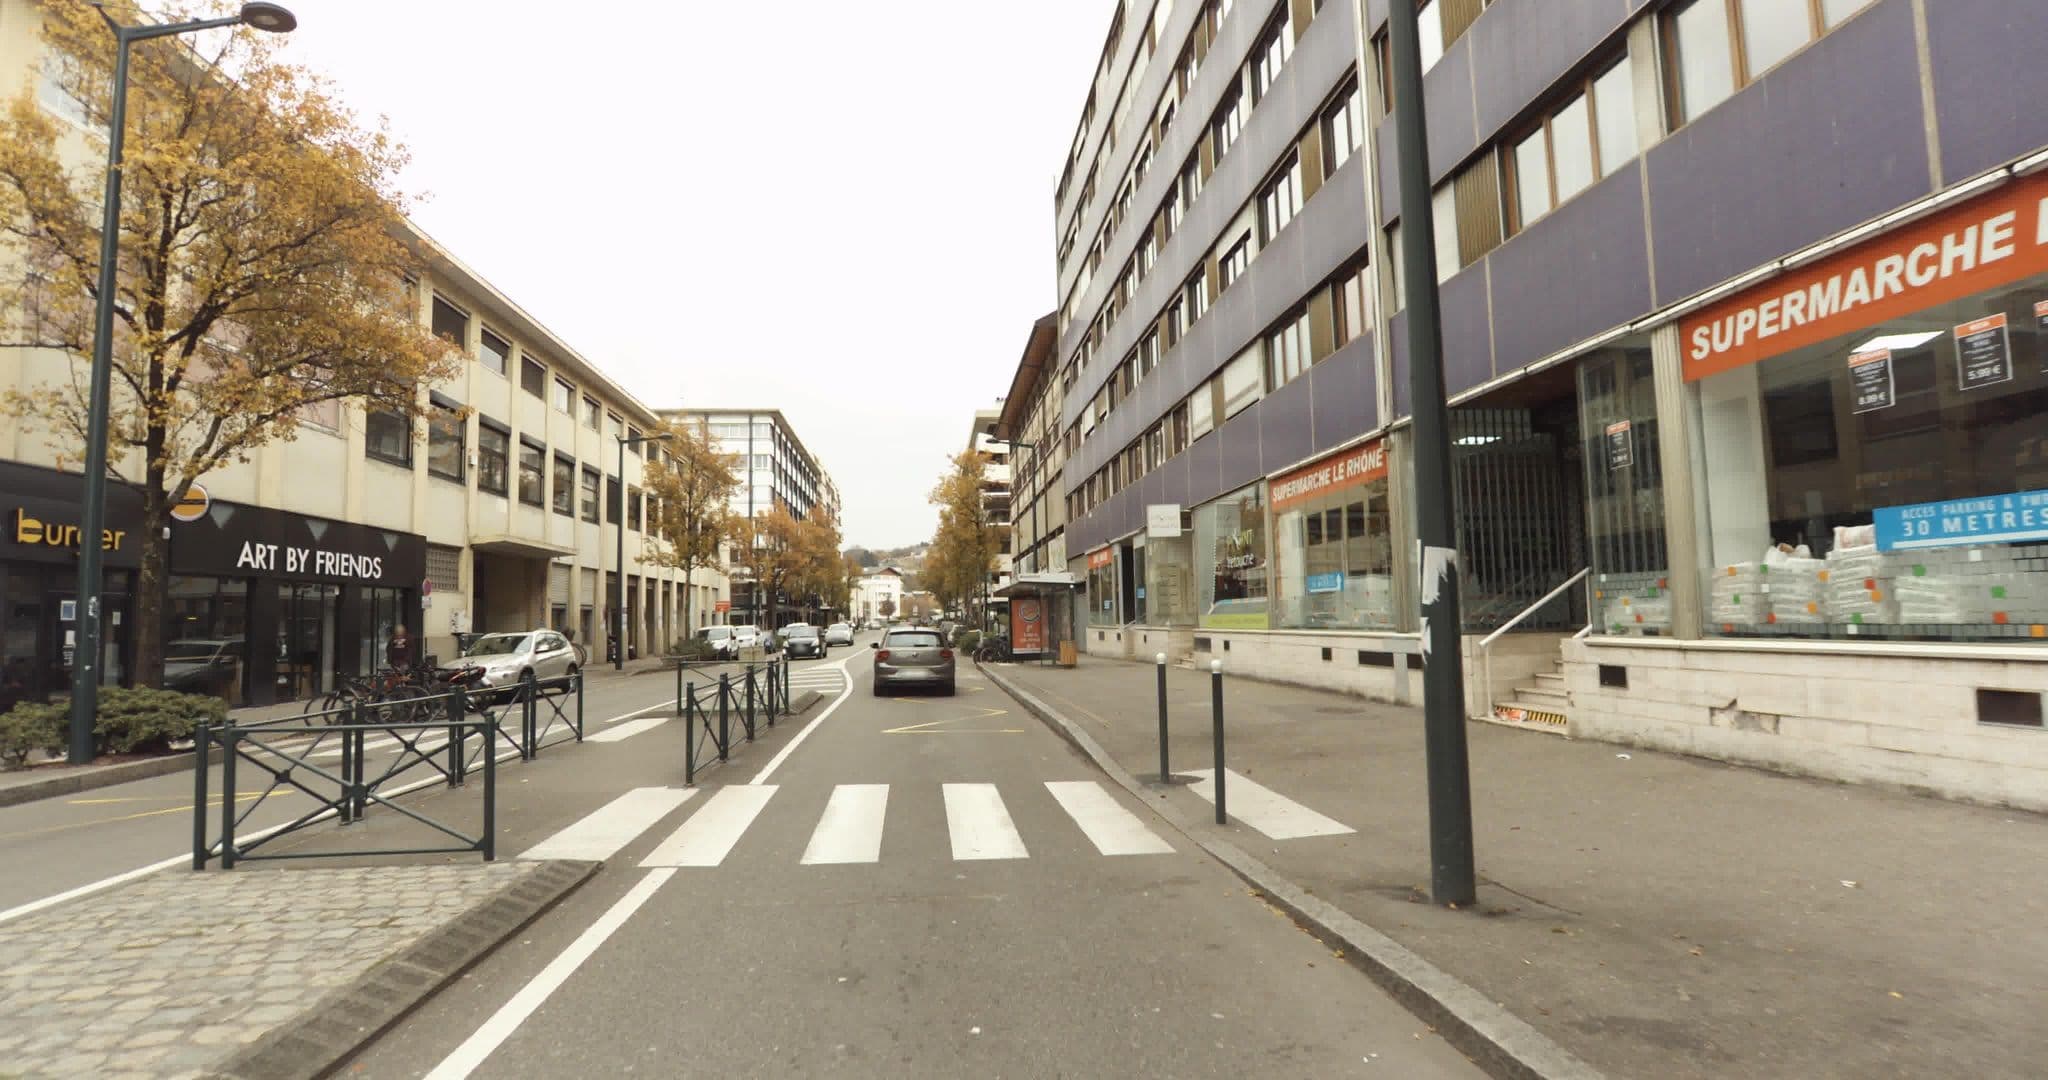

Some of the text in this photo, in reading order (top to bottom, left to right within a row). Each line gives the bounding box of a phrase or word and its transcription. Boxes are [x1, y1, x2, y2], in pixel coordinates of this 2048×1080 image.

[1690, 209, 2016, 361] SUPERMARCHE
[1272, 447, 1384, 503] SUPERMARCHE LE RHÔNE
[1902, 508, 2048, 537] 30 METRES
[1943, 498, 1995, 516] PARKING
[17, 507, 127, 556] burer
[236, 540, 383, 579] ART BY FRIENDS
